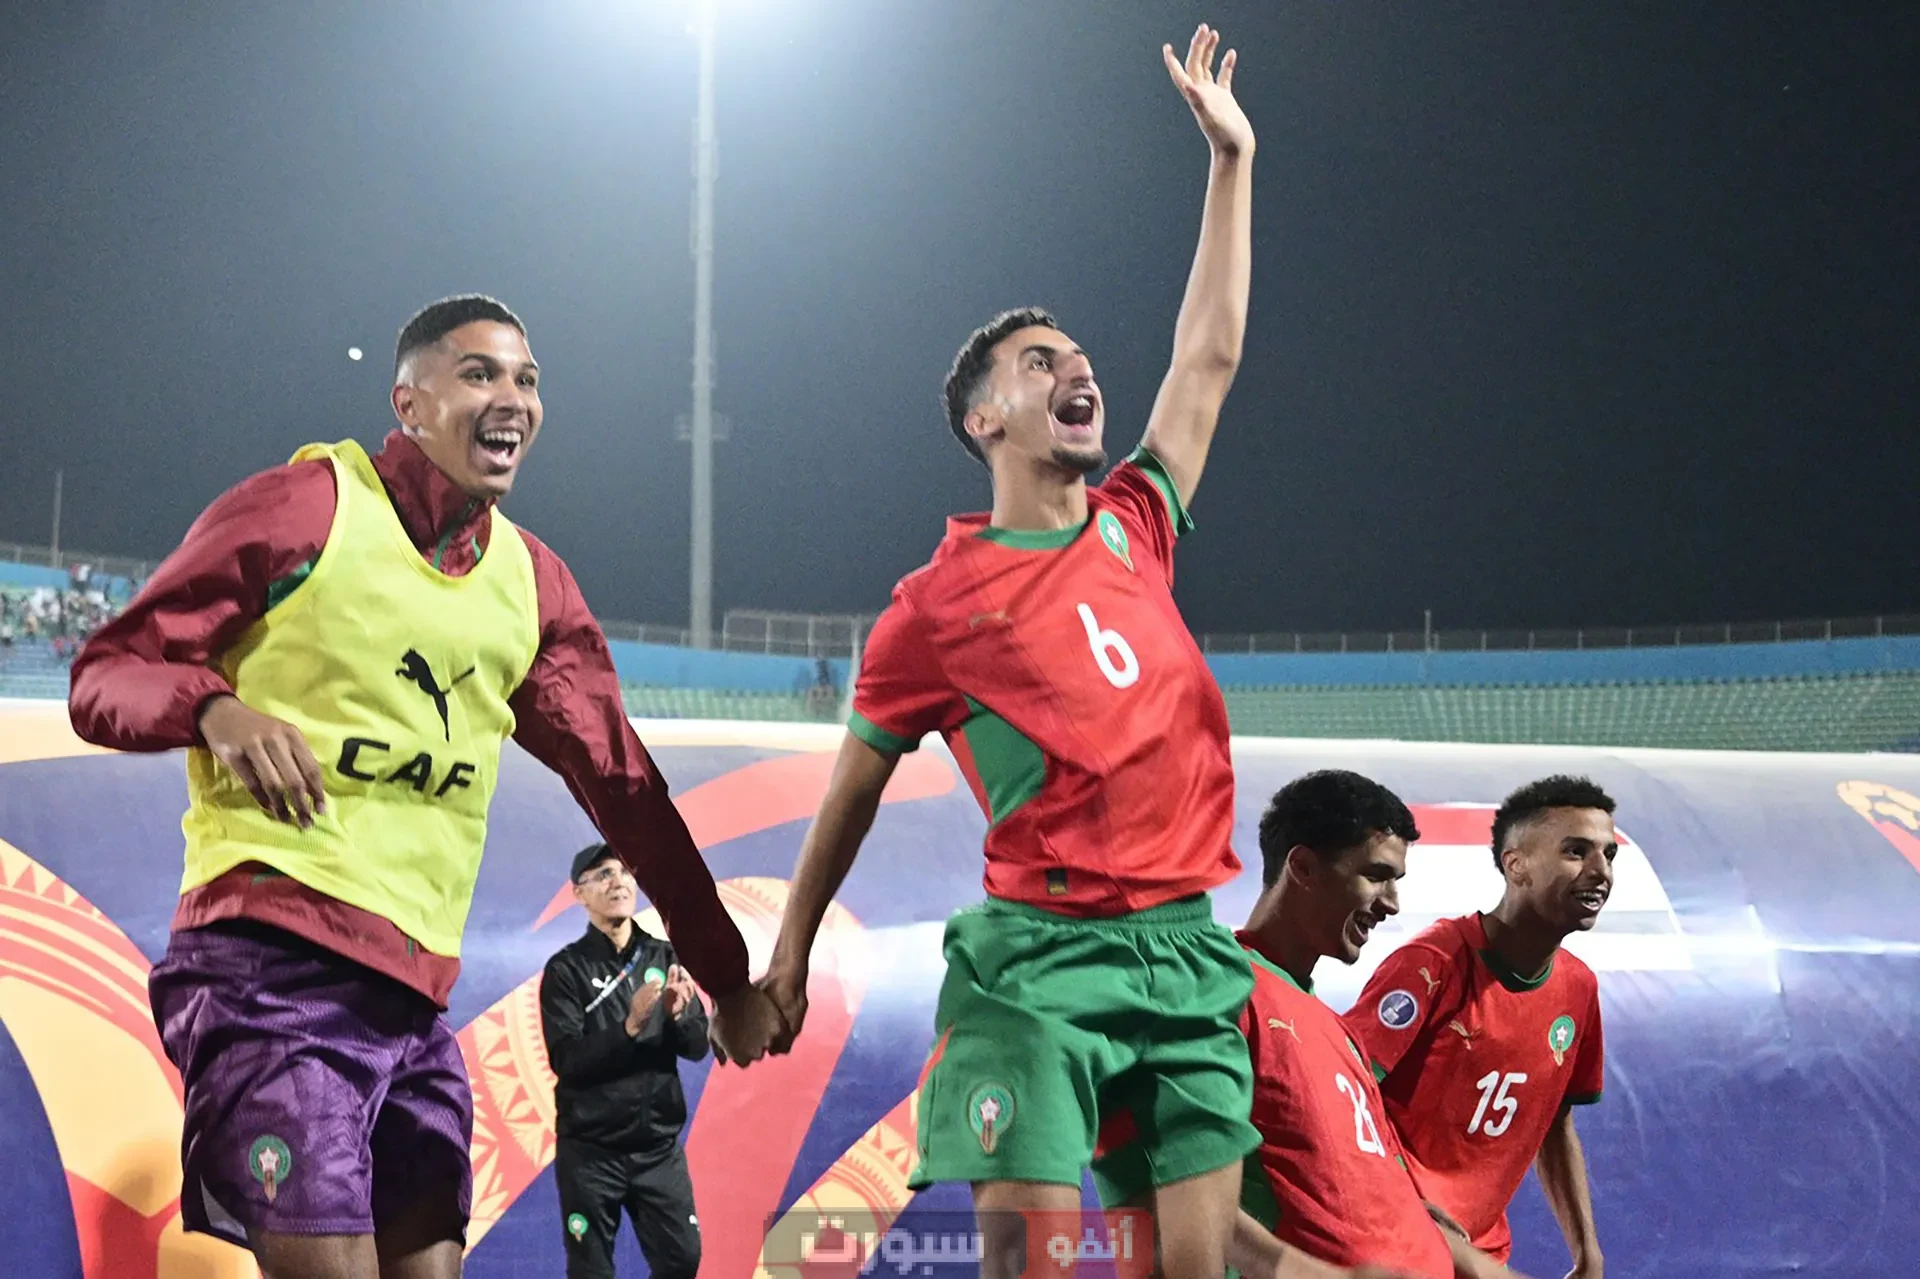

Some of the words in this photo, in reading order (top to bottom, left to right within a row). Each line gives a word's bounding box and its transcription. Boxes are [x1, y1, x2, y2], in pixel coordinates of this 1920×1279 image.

[1076, 602, 1140, 689] 6
[336, 736, 476, 798] CAF
[1466, 1070, 1528, 1137] 15
